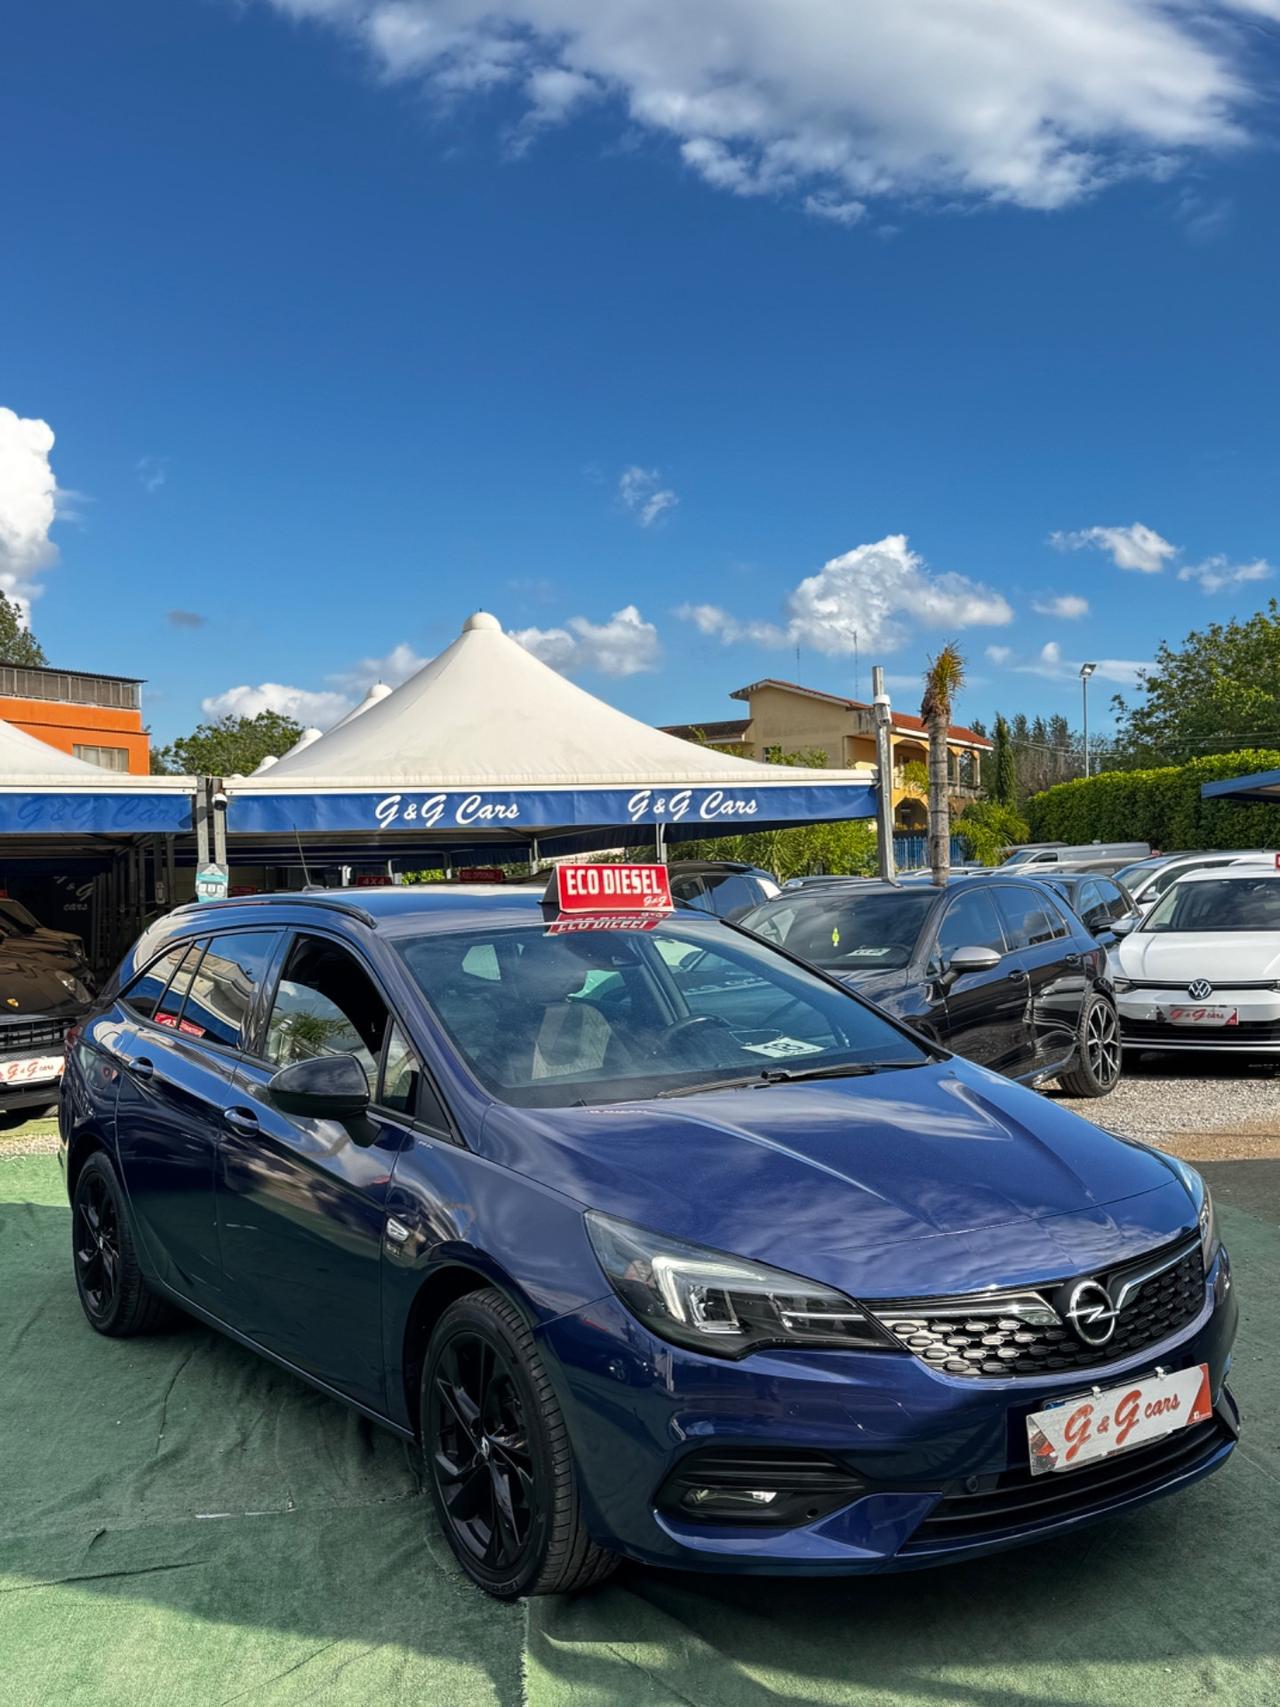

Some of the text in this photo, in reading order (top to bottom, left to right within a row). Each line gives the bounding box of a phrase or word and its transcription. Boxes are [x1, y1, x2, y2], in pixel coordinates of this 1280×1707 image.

[455, 794, 520, 824] Cars
[699, 791, 758, 819] Cars
[566, 869, 662, 895] ECO DIESEL
[1144, 1393, 1181, 1419] cars
